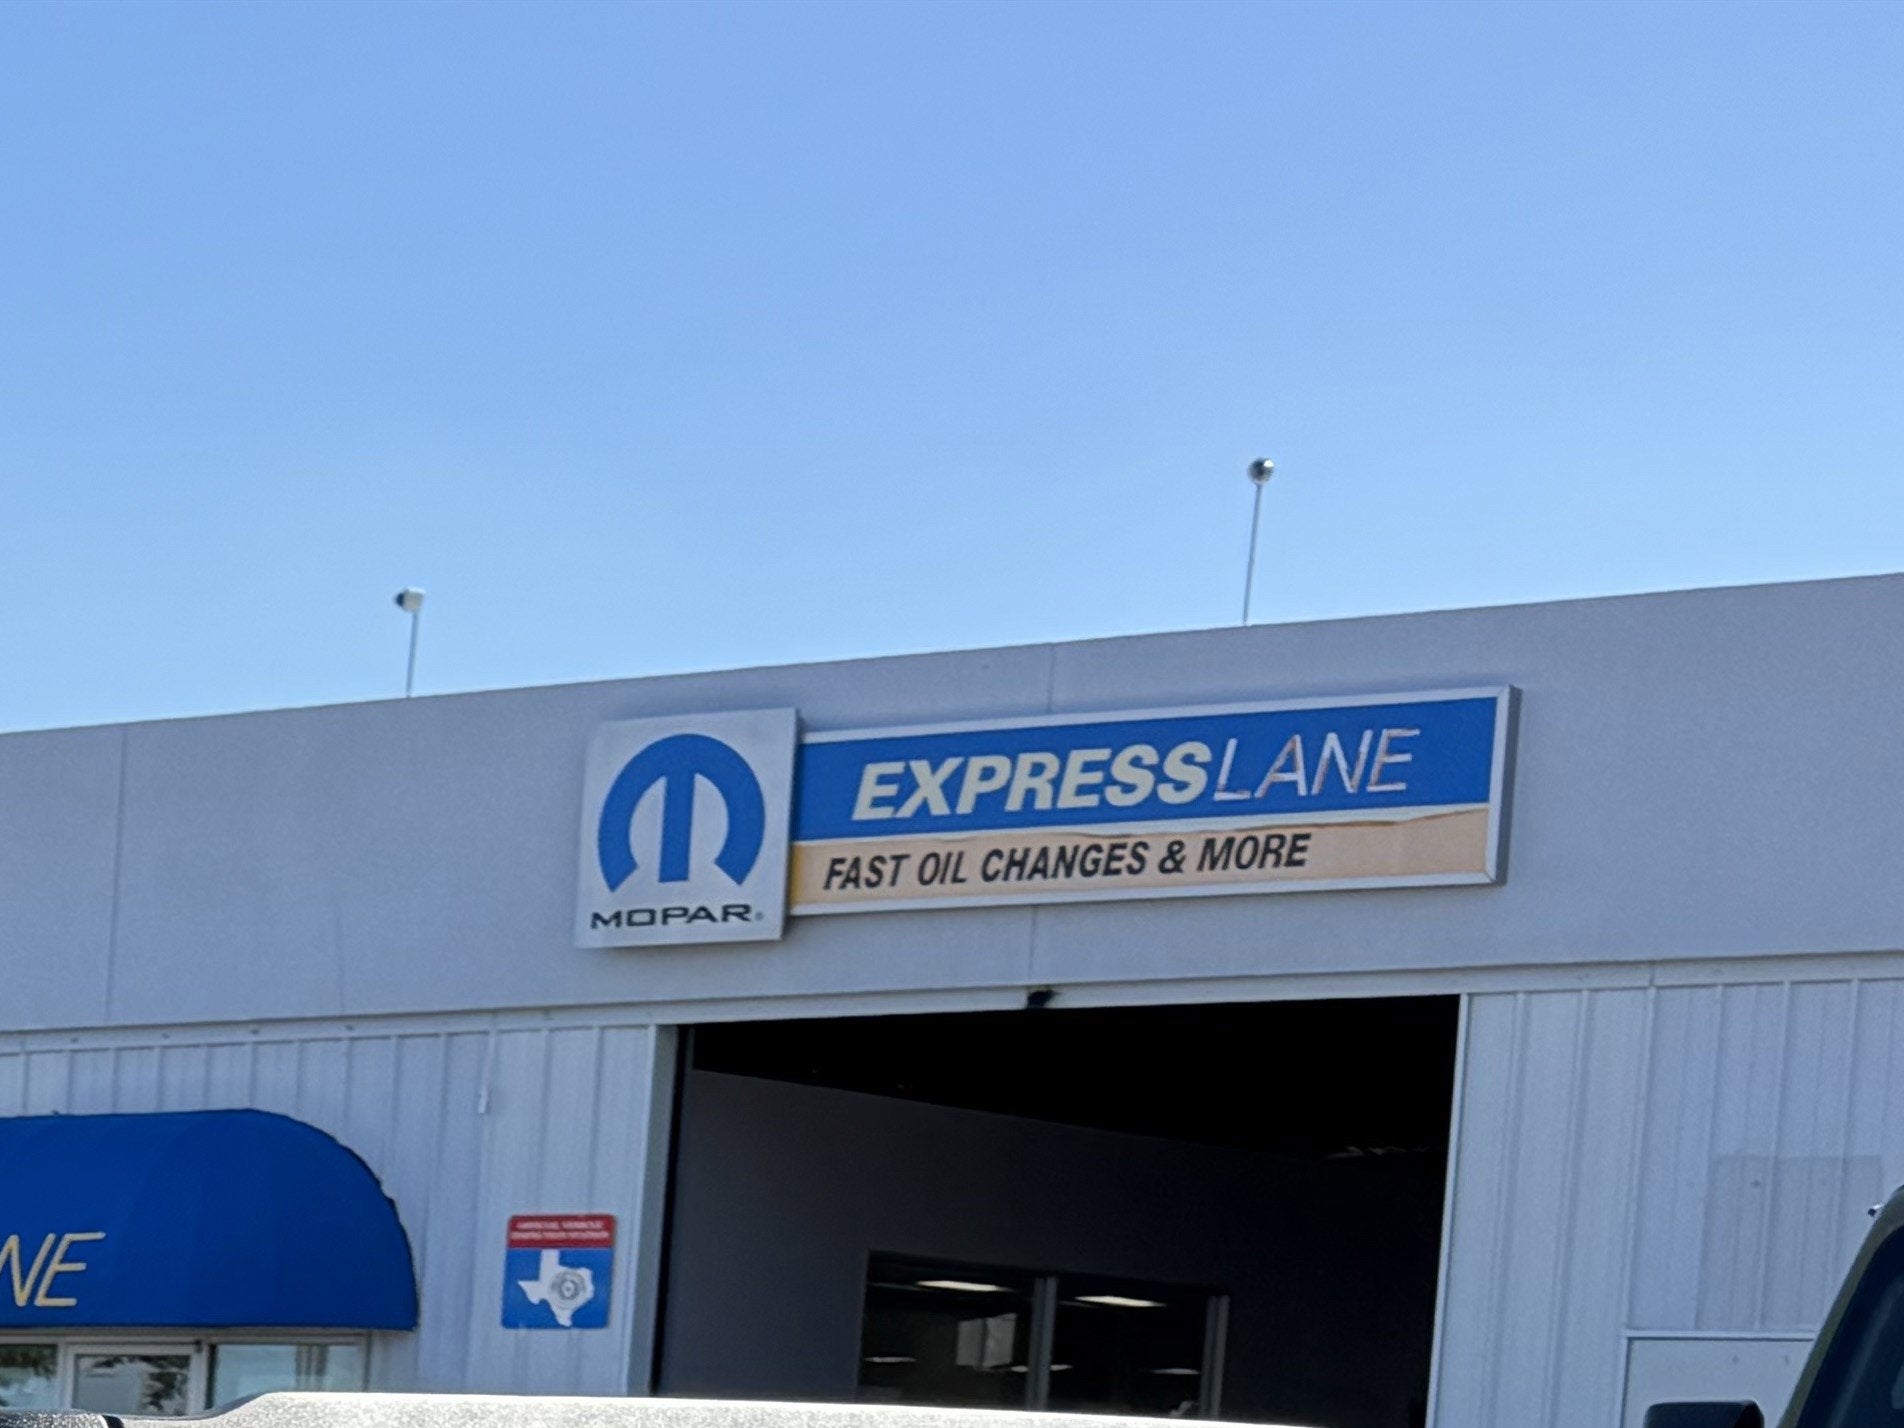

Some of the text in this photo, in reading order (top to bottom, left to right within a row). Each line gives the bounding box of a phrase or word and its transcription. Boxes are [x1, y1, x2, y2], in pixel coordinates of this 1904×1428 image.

[823, 832, 1312, 891] FAST OIL CHANGES & MORE
[590, 904, 752, 930] MOPAR
